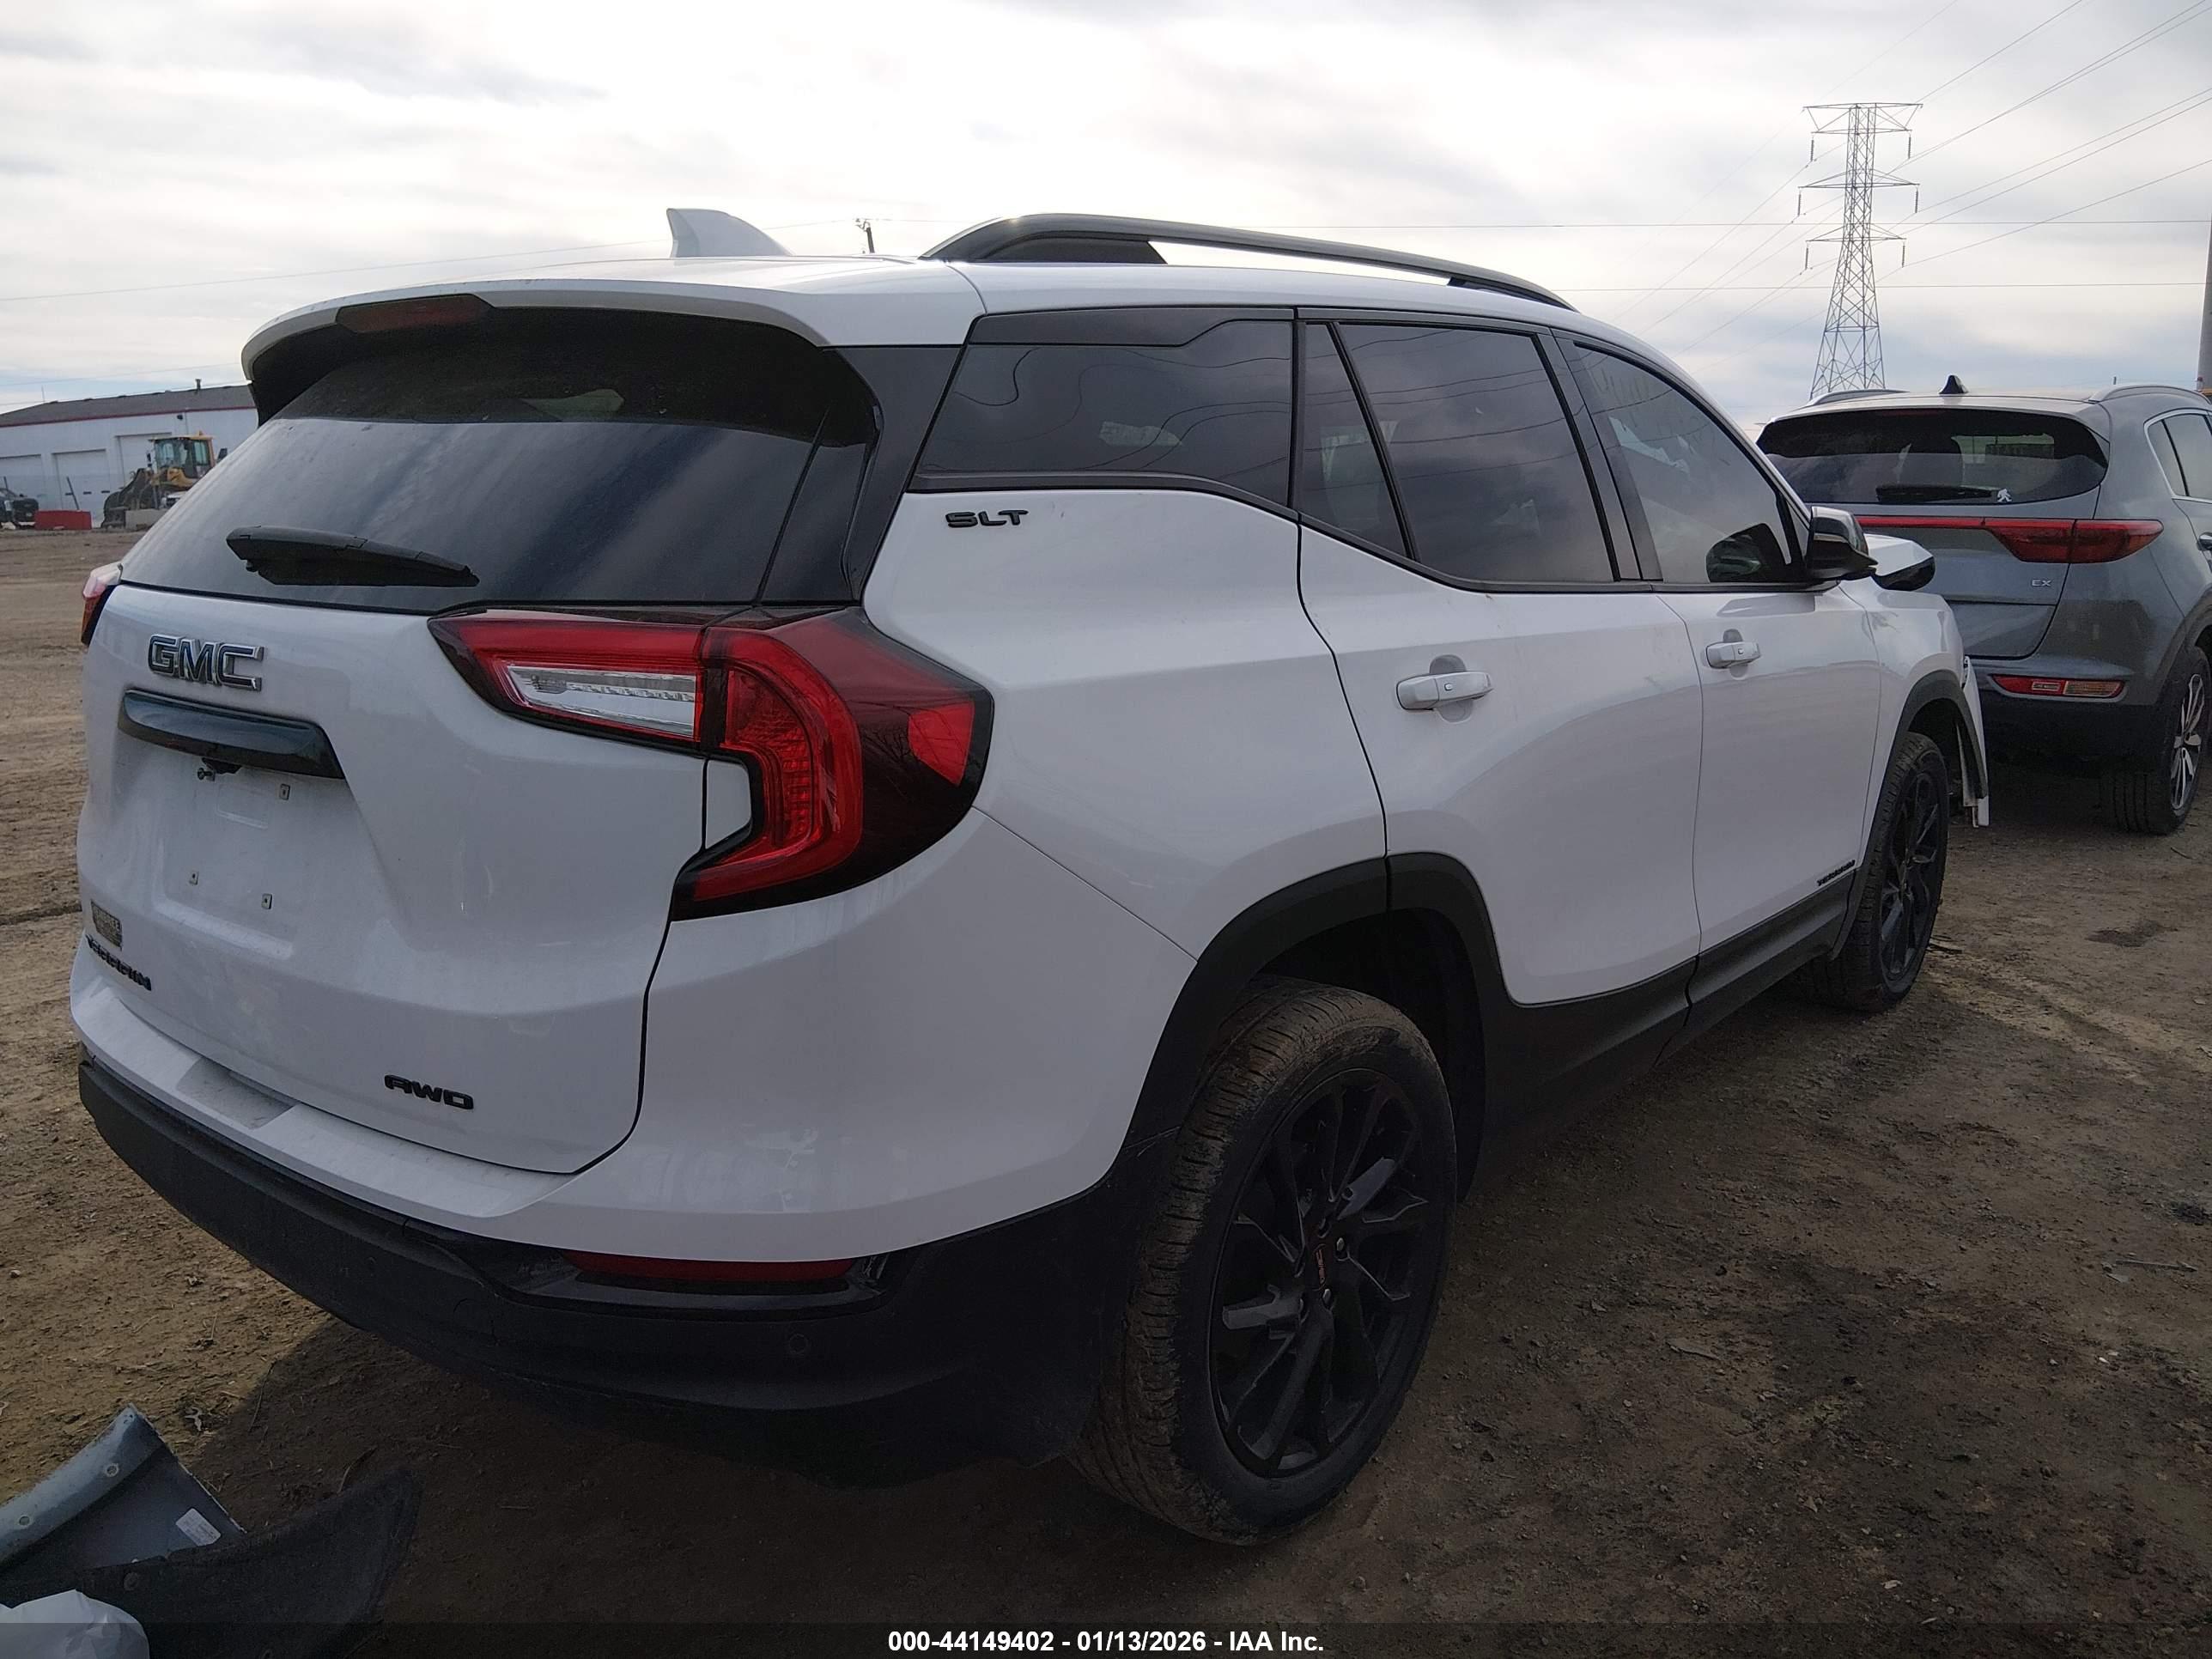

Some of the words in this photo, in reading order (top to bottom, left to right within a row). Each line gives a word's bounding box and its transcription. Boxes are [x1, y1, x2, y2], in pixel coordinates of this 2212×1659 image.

[945, 509, 1029, 528] SLT
[148, 634, 264, 692] GMC
[384, 1074, 474, 1110] AWD
